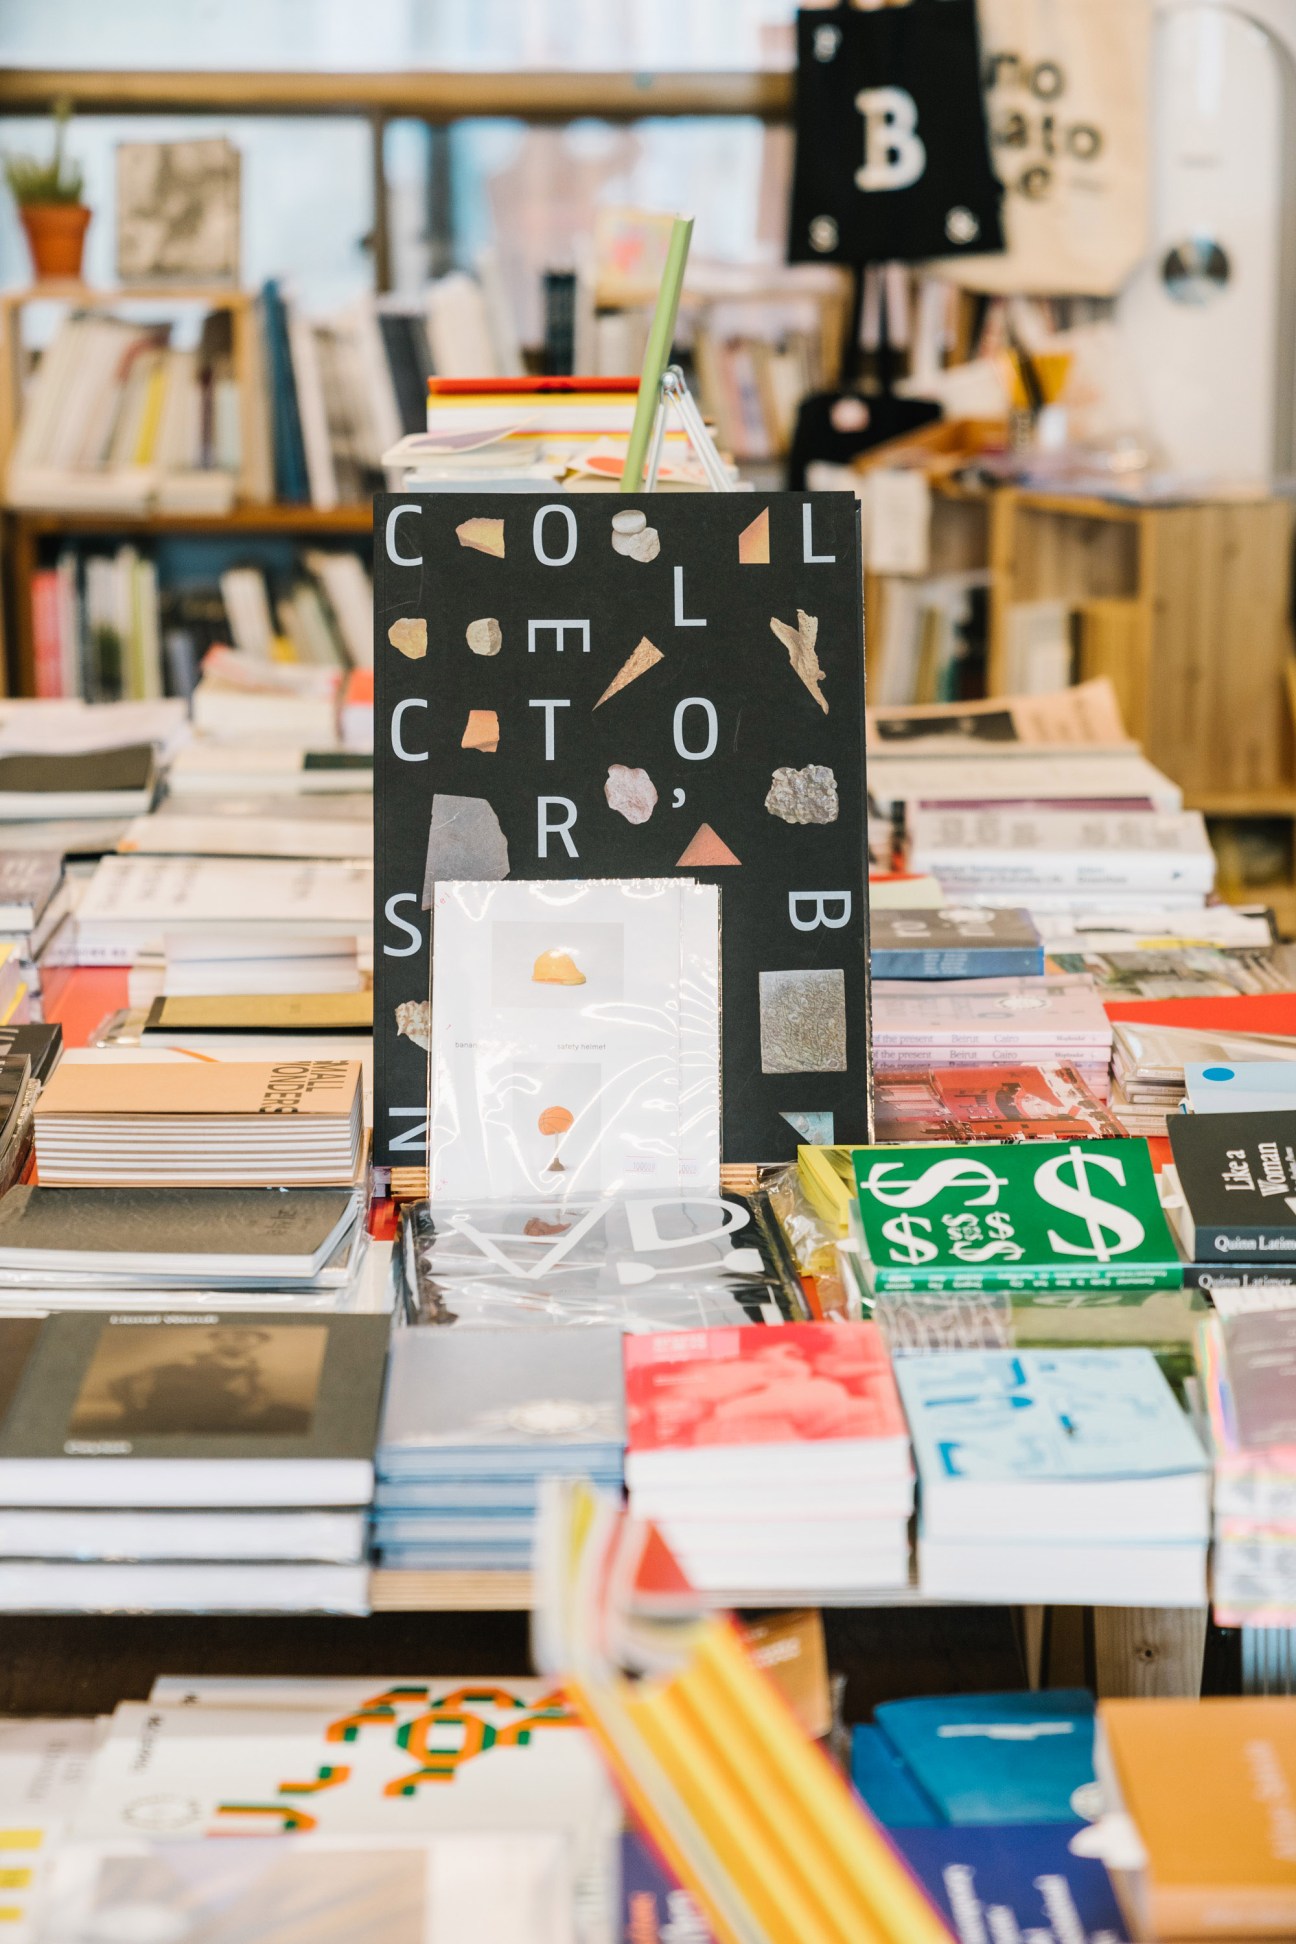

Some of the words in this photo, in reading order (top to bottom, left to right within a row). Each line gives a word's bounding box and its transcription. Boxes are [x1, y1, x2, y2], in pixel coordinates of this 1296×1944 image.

[853, 86, 927, 192] B
[386, 505, 423, 566] C
[532, 504, 578, 566] O
[803, 503, 835, 563] L
[673, 566, 707, 626] L
[391, 698, 429, 762] C
[528, 699, 571, 761] T
[537, 796, 580, 858] R
[383, 893, 423, 957] S
[788, 890, 852, 931] B
[454, 1041, 479, 1049] banan
[949, 1049, 978, 1059] Beirut
[991, 1049, 1019, 1059] Cairo
[951, 1034, 980, 1043] Beirut
[993, 1034, 1020, 1043] Cairo
[1221, 1160, 1256, 1192] Like
[1256, 1141, 1290, 1198] Woman
[1213, 1234, 1258, 1253] Quinn
